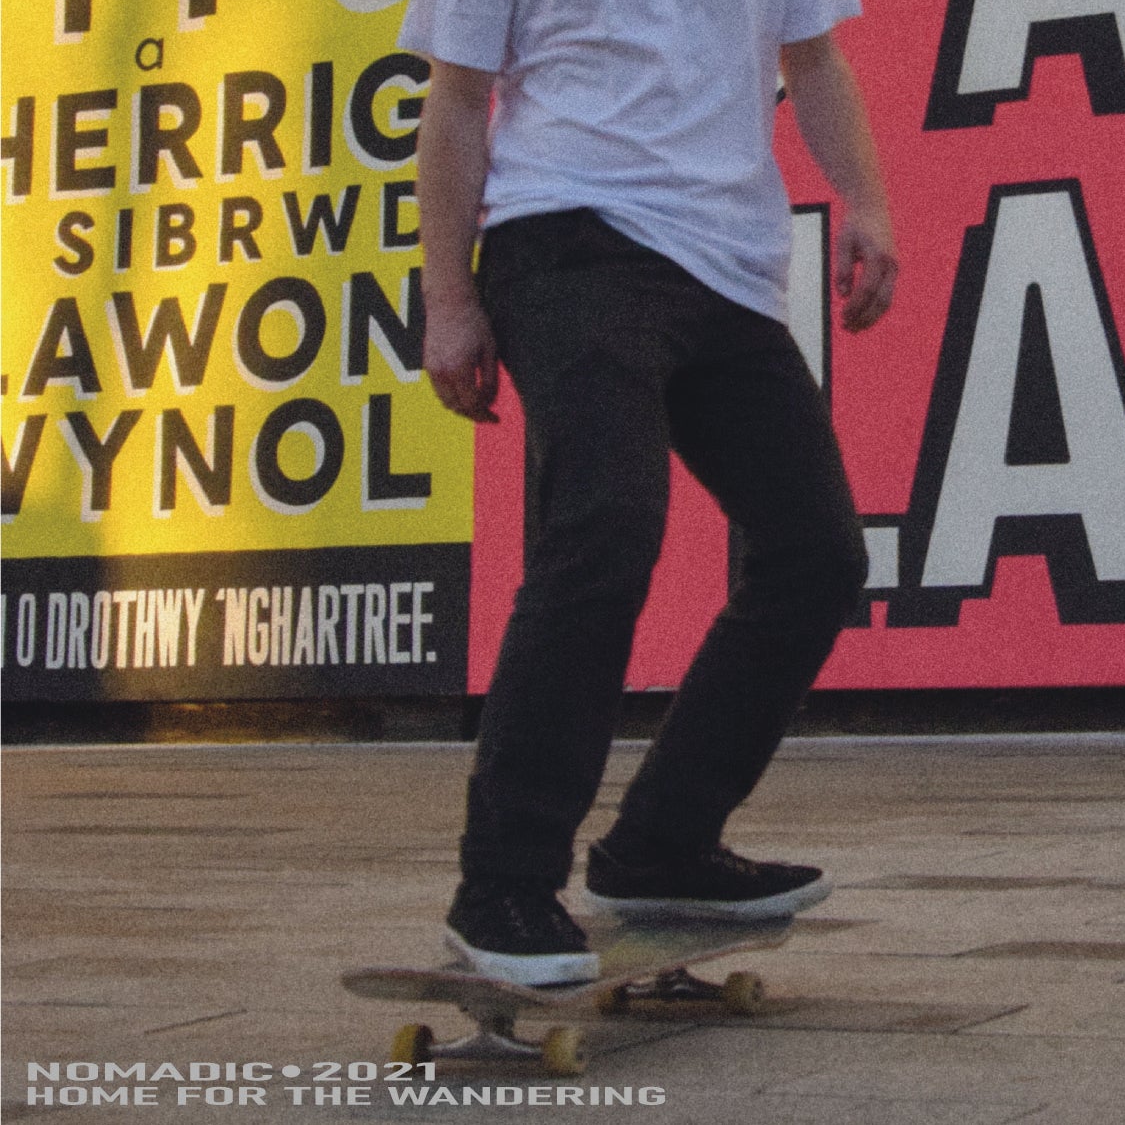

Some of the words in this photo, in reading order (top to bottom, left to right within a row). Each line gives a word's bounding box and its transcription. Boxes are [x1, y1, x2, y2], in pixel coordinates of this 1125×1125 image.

[135, 37, 164, 71] a
[53, 180, 424, 277] SIBRWD
[0, 267, 426, 401] AWON
[16, 592, 36, 668] O
[45, 587, 205, 670] DROTHWY
